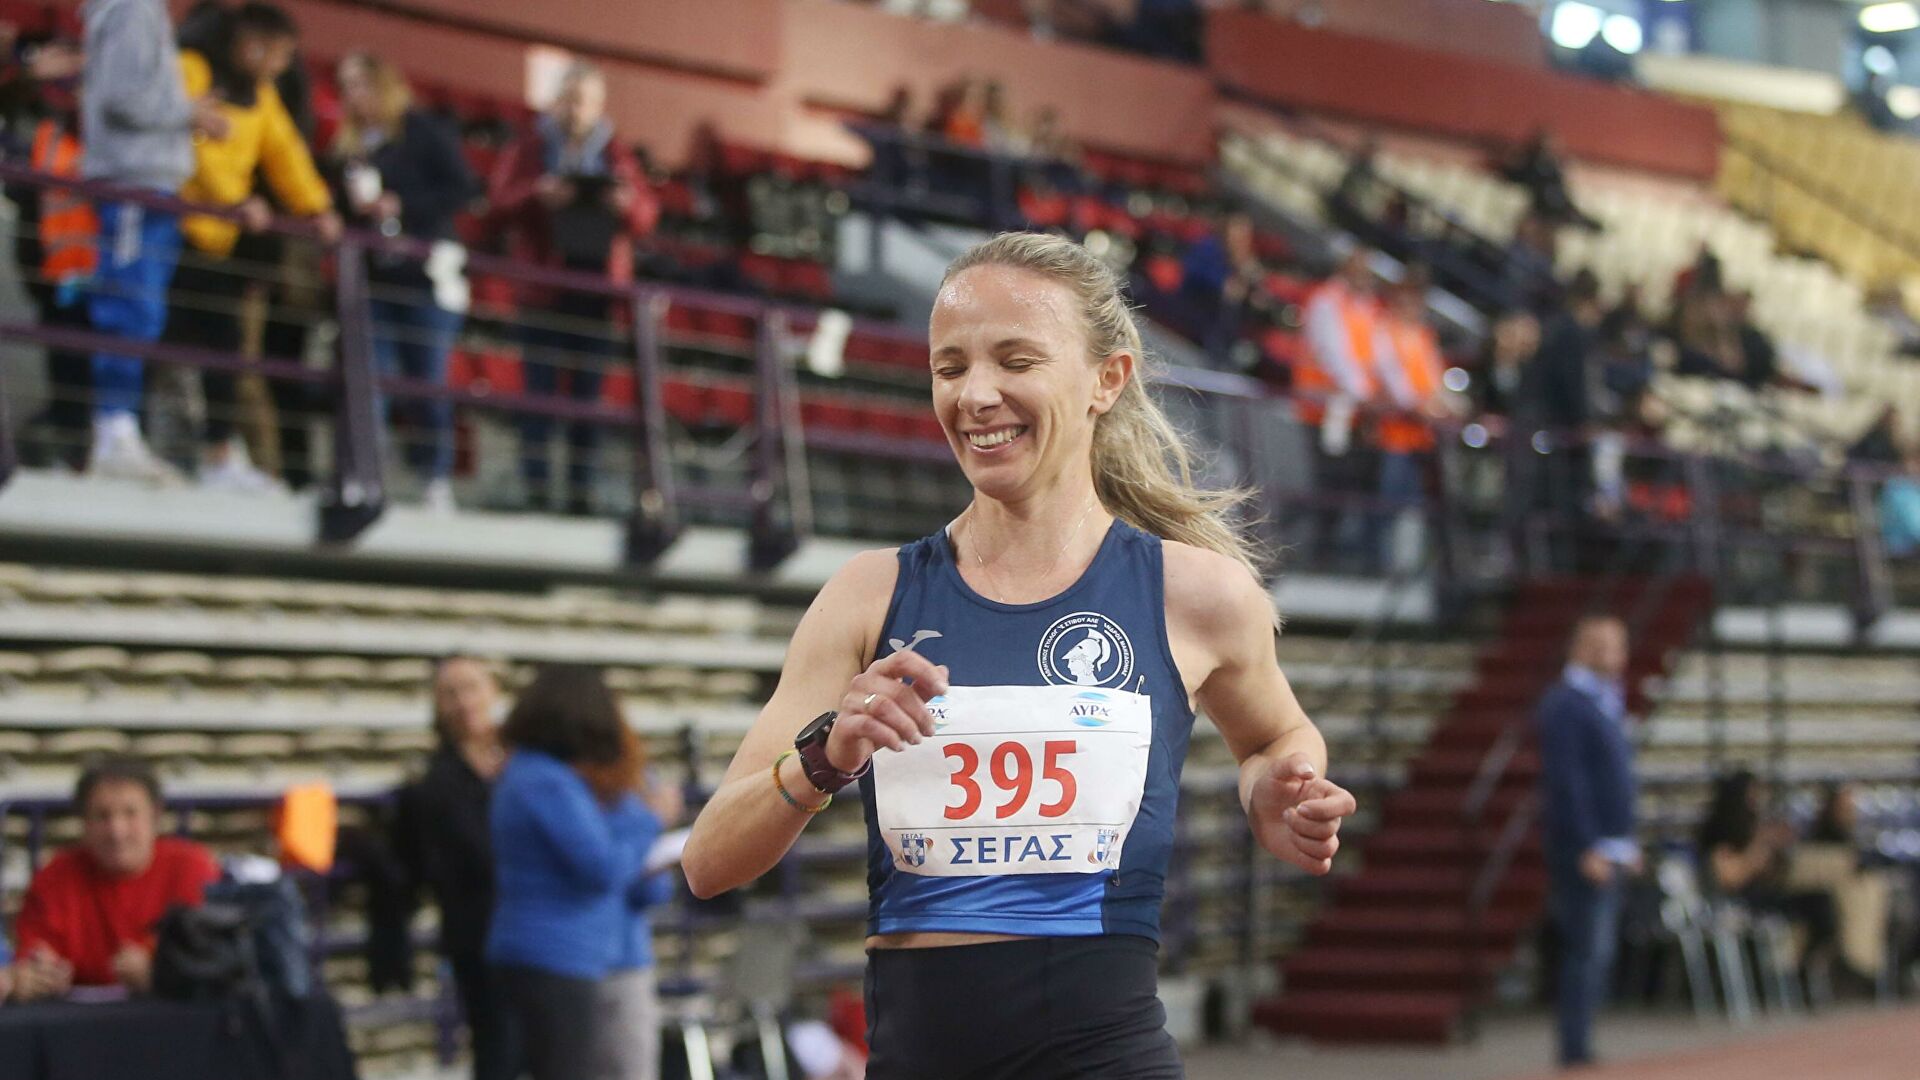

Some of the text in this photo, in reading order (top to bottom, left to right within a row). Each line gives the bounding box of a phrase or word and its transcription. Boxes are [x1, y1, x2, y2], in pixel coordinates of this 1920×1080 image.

[1068, 704, 1111, 717] ΑΥΡΑ
[943, 740, 1077, 820] 395
[950, 835, 1072, 864] ΣΕΓΑΣ
